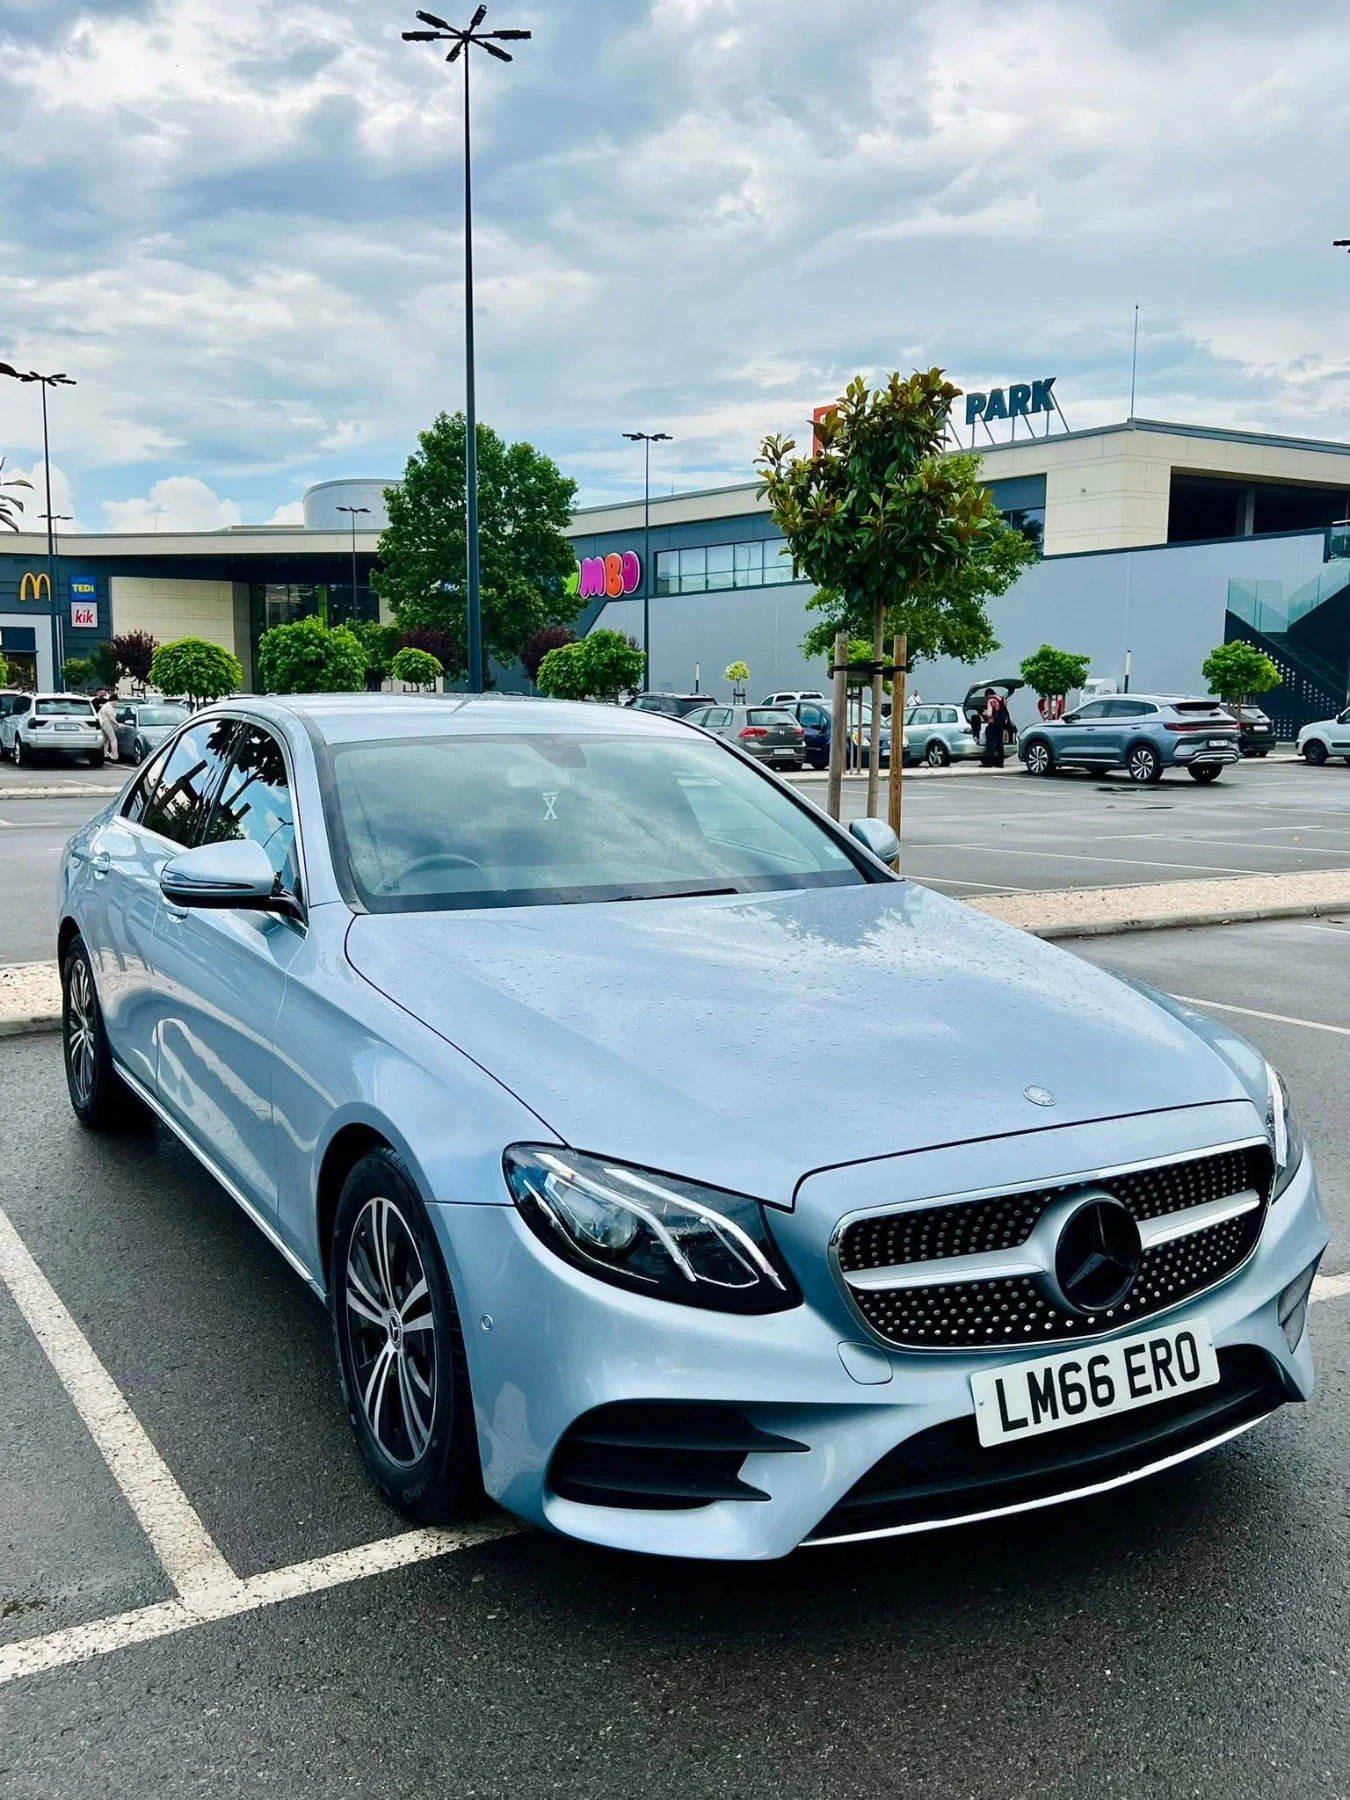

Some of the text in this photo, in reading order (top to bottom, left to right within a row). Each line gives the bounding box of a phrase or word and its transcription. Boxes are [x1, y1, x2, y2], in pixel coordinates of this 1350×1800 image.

[966, 377, 1057, 425] PARK
[71, 584, 95, 593] TEDi
[564, 550, 640, 599] MBO
[995, 1331, 1201, 1432] LM66 ERO
